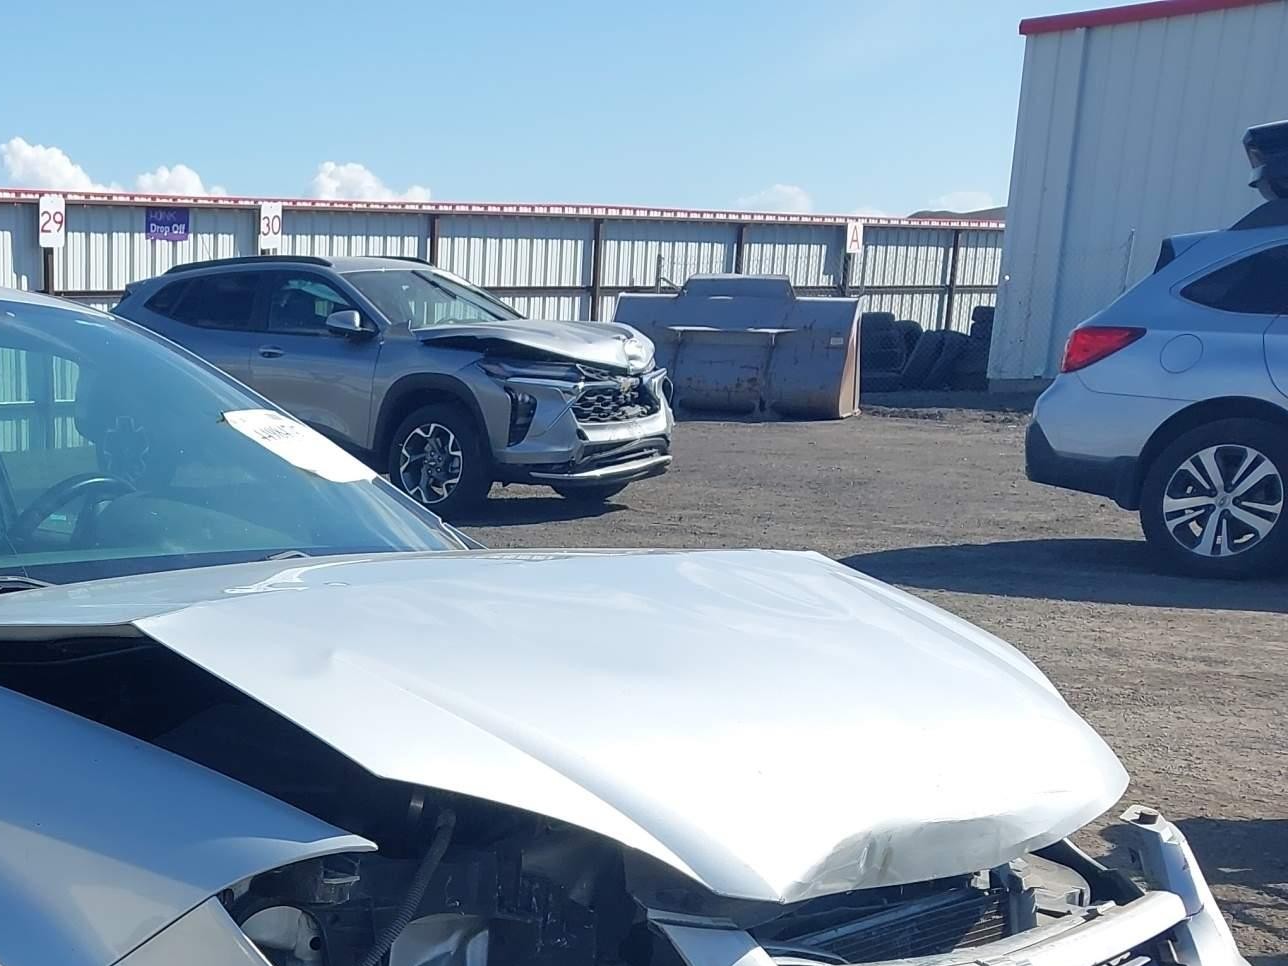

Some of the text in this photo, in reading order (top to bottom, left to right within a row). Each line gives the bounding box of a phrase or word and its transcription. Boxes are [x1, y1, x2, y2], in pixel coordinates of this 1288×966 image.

[40, 210, 64, 233] 29
[150, 223, 186, 236] Drop Off
[262, 214, 281, 236] 30
